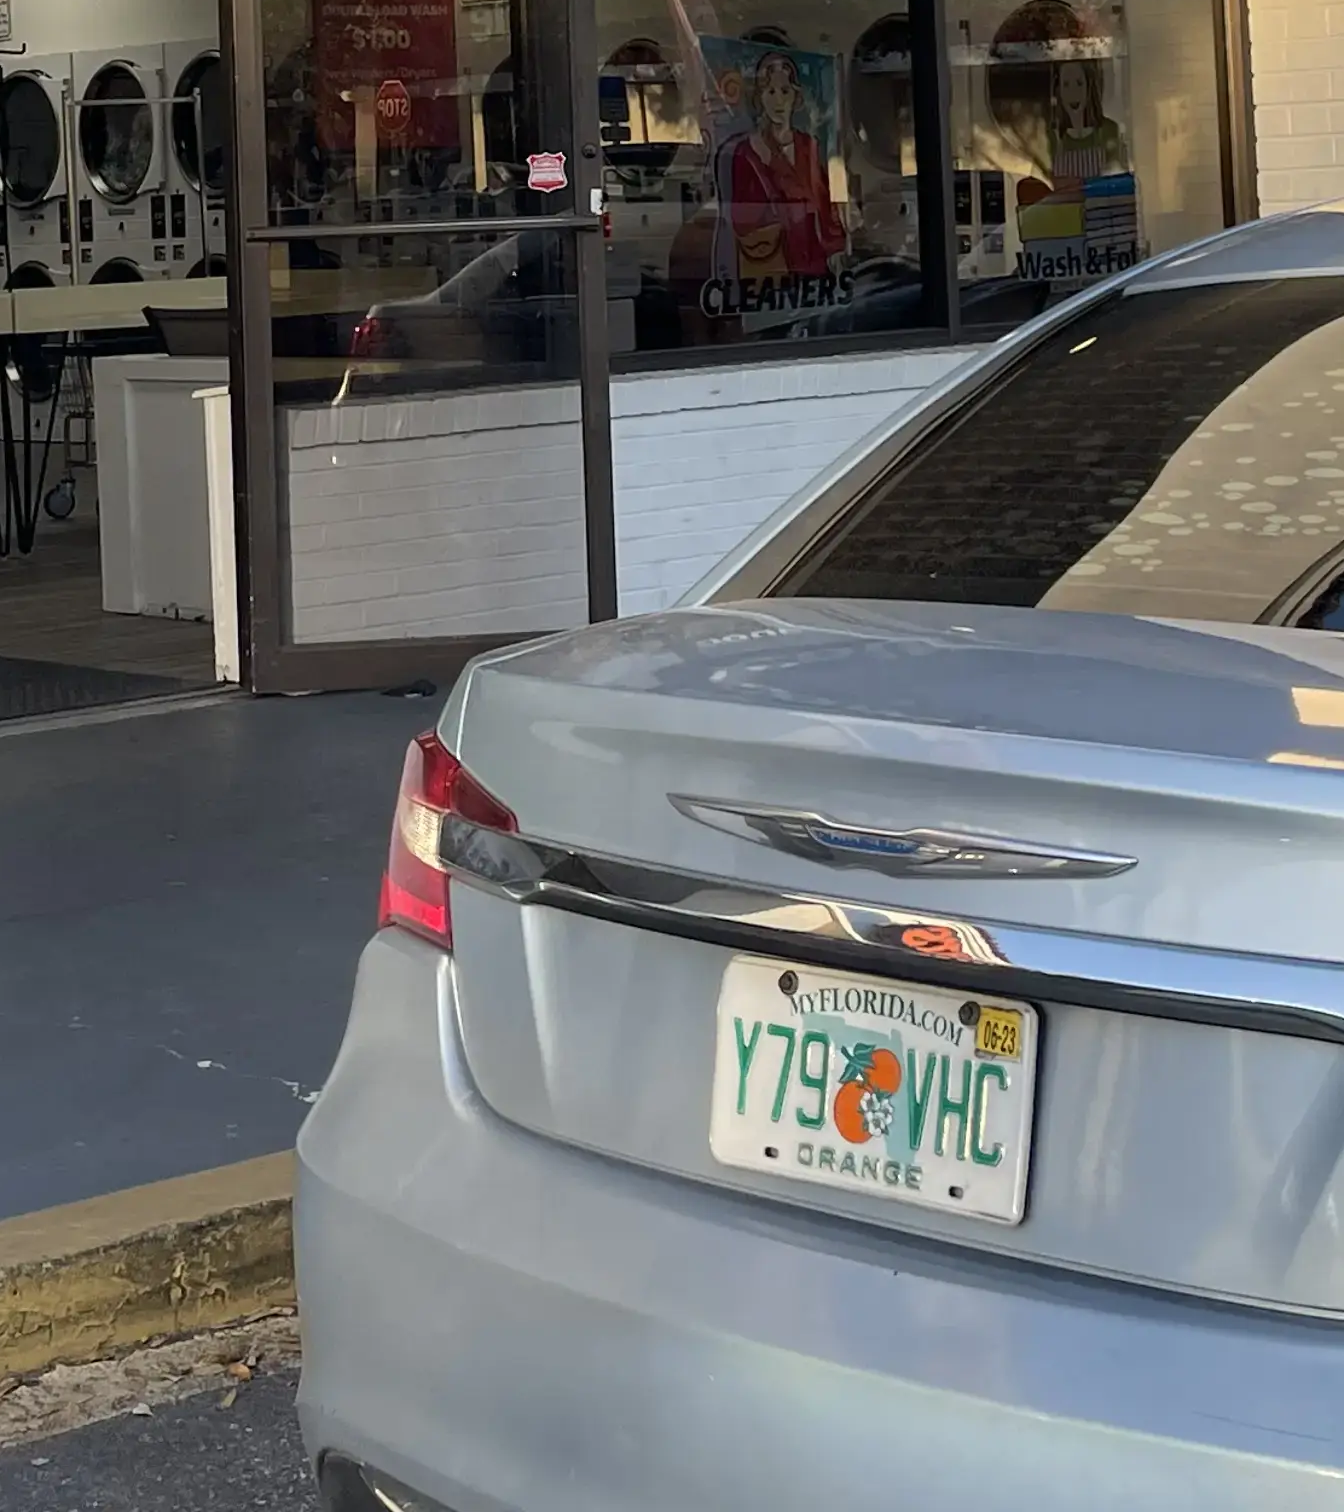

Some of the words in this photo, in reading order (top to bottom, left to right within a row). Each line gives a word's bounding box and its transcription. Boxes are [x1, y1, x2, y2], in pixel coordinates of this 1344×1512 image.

[410, 3, 449, 16] WASH
[1015, 246, 1082, 280] Wash
[1085, 246, 1103, 275] &
[701, 270, 856, 317] CLEANERS
[789, 987, 965, 1048] MYFLORIDA.COM
[983, 1019, 1017, 1055] 06-23
[732, 1017, 833, 1131] Y79
[905, 1047, 1010, 1168] VHC
[796, 1142, 924, 1191] ORANGE
